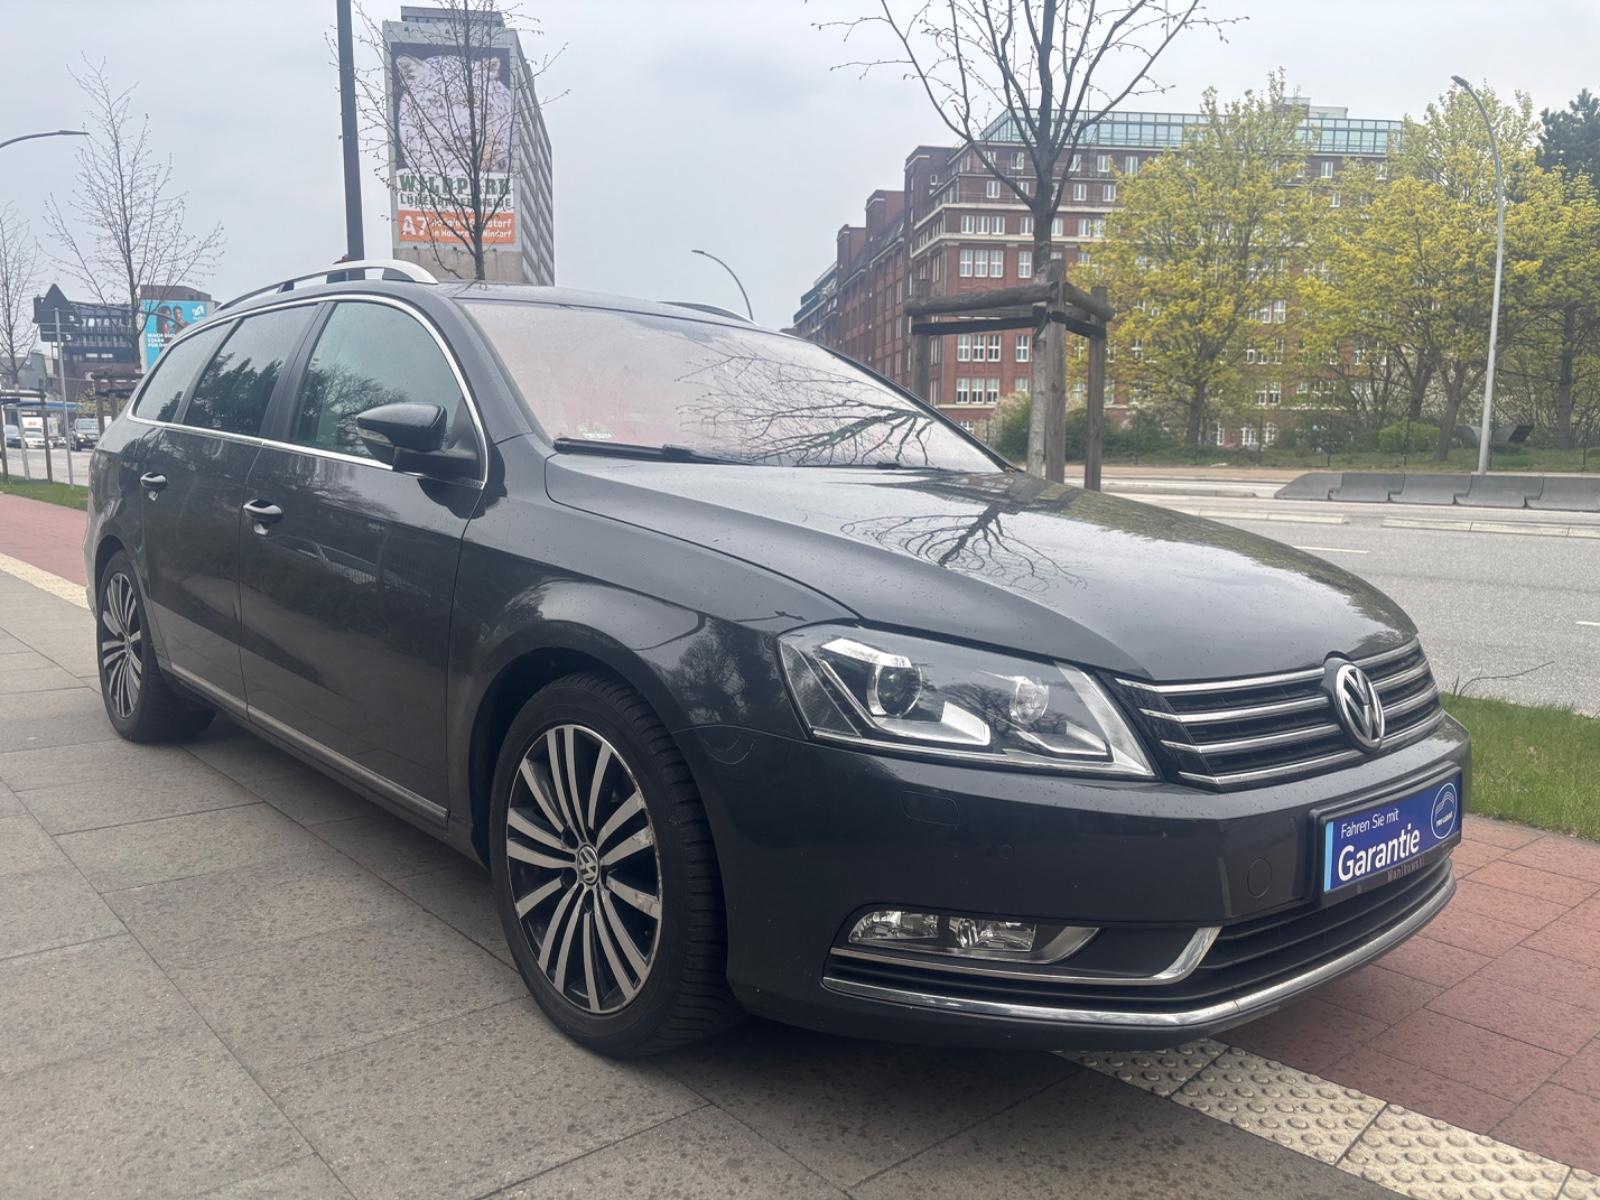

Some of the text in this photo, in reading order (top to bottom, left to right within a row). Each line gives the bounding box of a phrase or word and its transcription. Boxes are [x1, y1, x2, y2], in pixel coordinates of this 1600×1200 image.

[1341, 808, 1399, 839] Fahren Sie mit
[1338, 823, 1420, 881] Garantie
